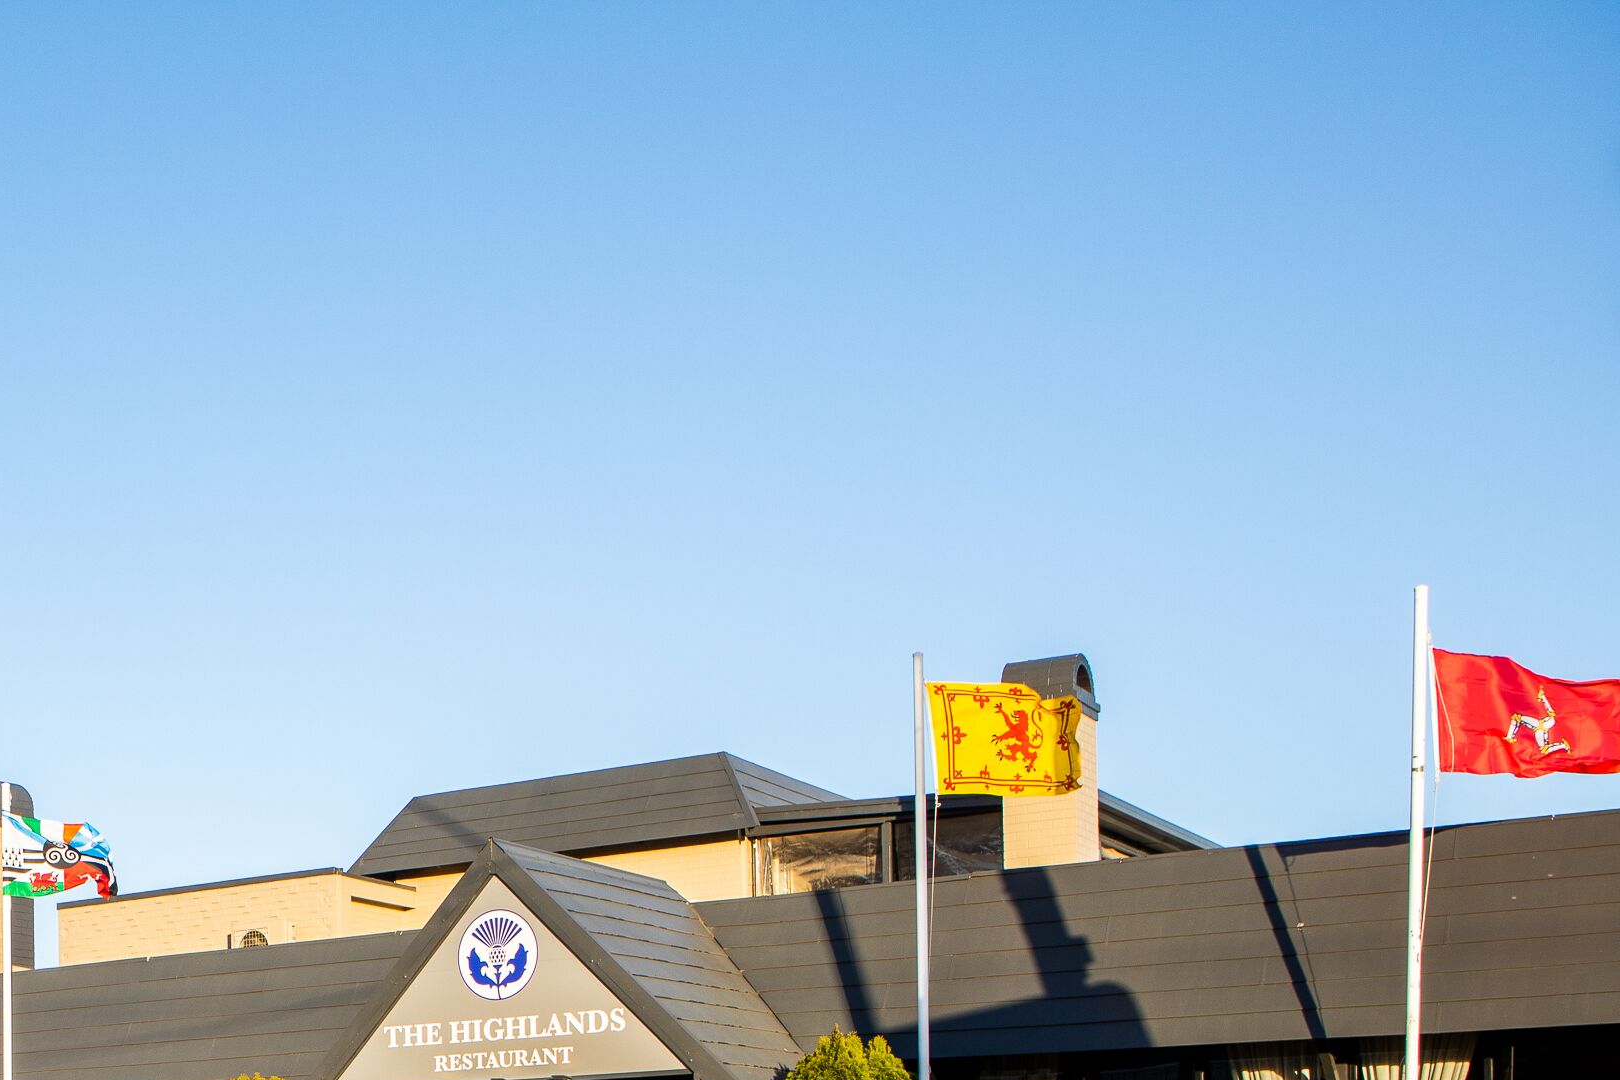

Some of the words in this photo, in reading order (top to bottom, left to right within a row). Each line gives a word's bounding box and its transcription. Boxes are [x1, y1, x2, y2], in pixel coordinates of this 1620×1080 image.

[383, 1022, 442, 1048] THE
[448, 1007, 627, 1045] HIGHLANDS
[433, 1046, 574, 1072] RESTAURANT
